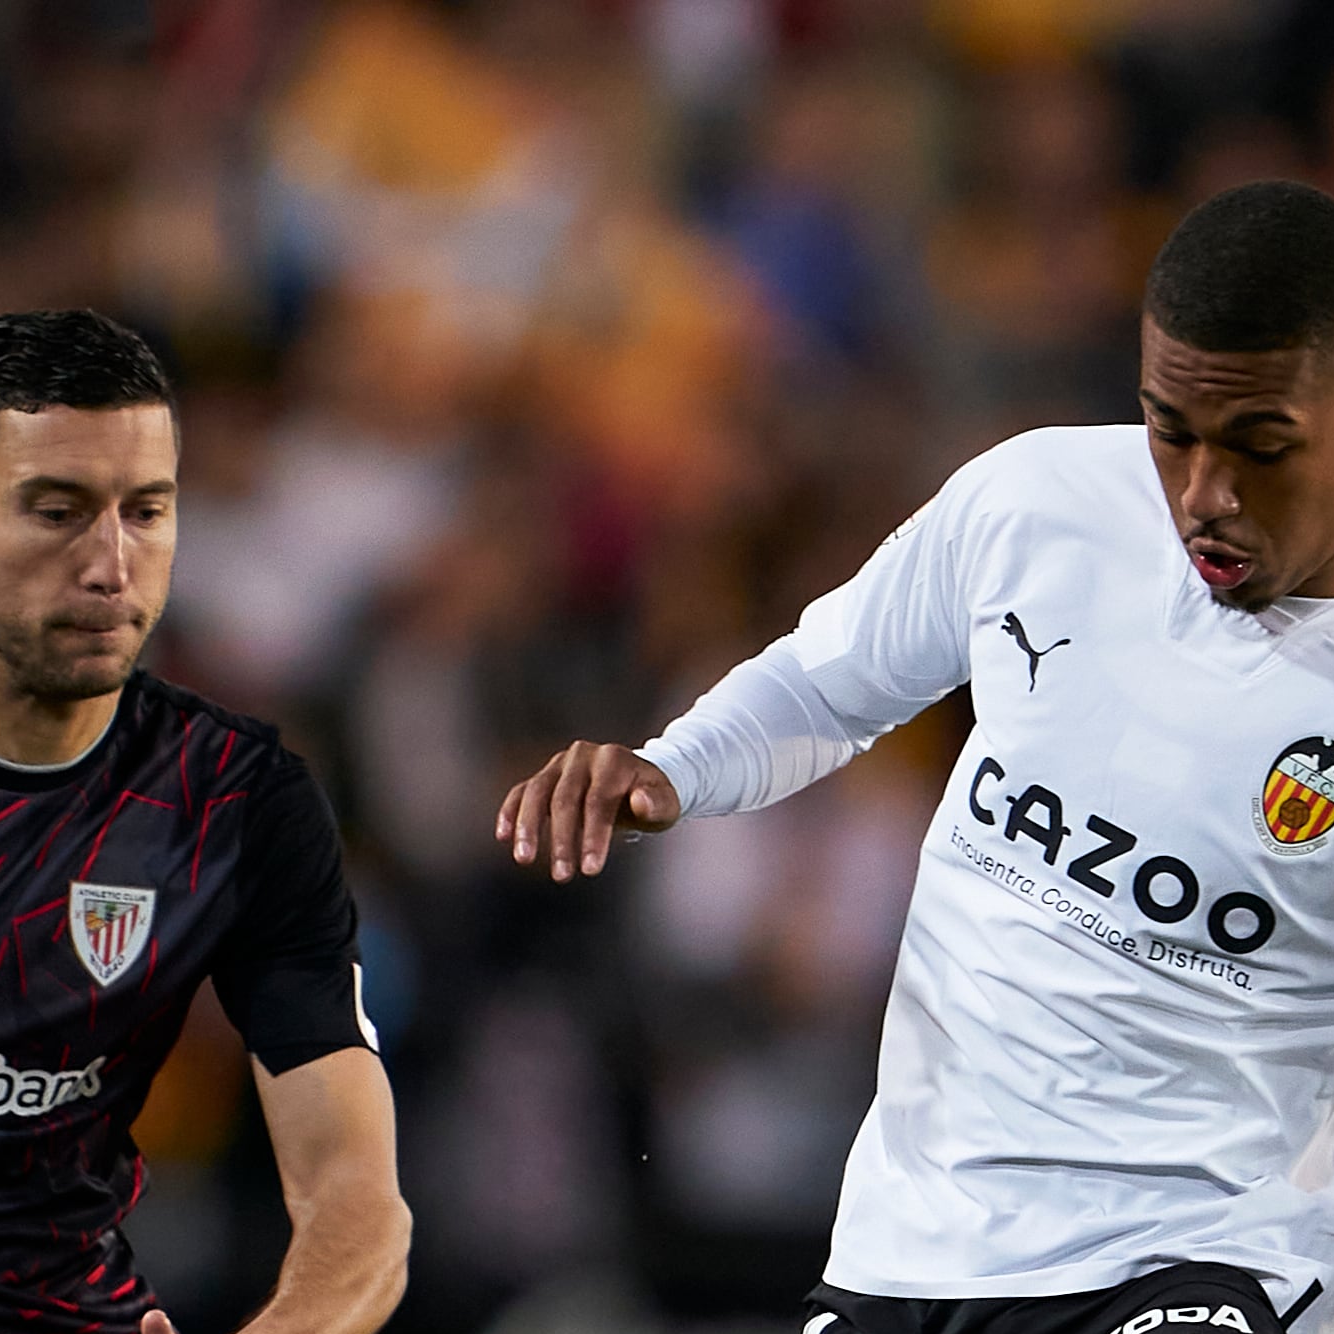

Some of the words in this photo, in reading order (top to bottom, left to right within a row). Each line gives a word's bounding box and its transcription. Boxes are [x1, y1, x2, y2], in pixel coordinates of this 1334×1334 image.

[950, 825, 1035, 897] Encuentra.
[1041, 888, 1139, 956] Conduce.
[1147, 940, 1253, 991] Disfruta.
[969, 757, 1276, 954] CAZOO
